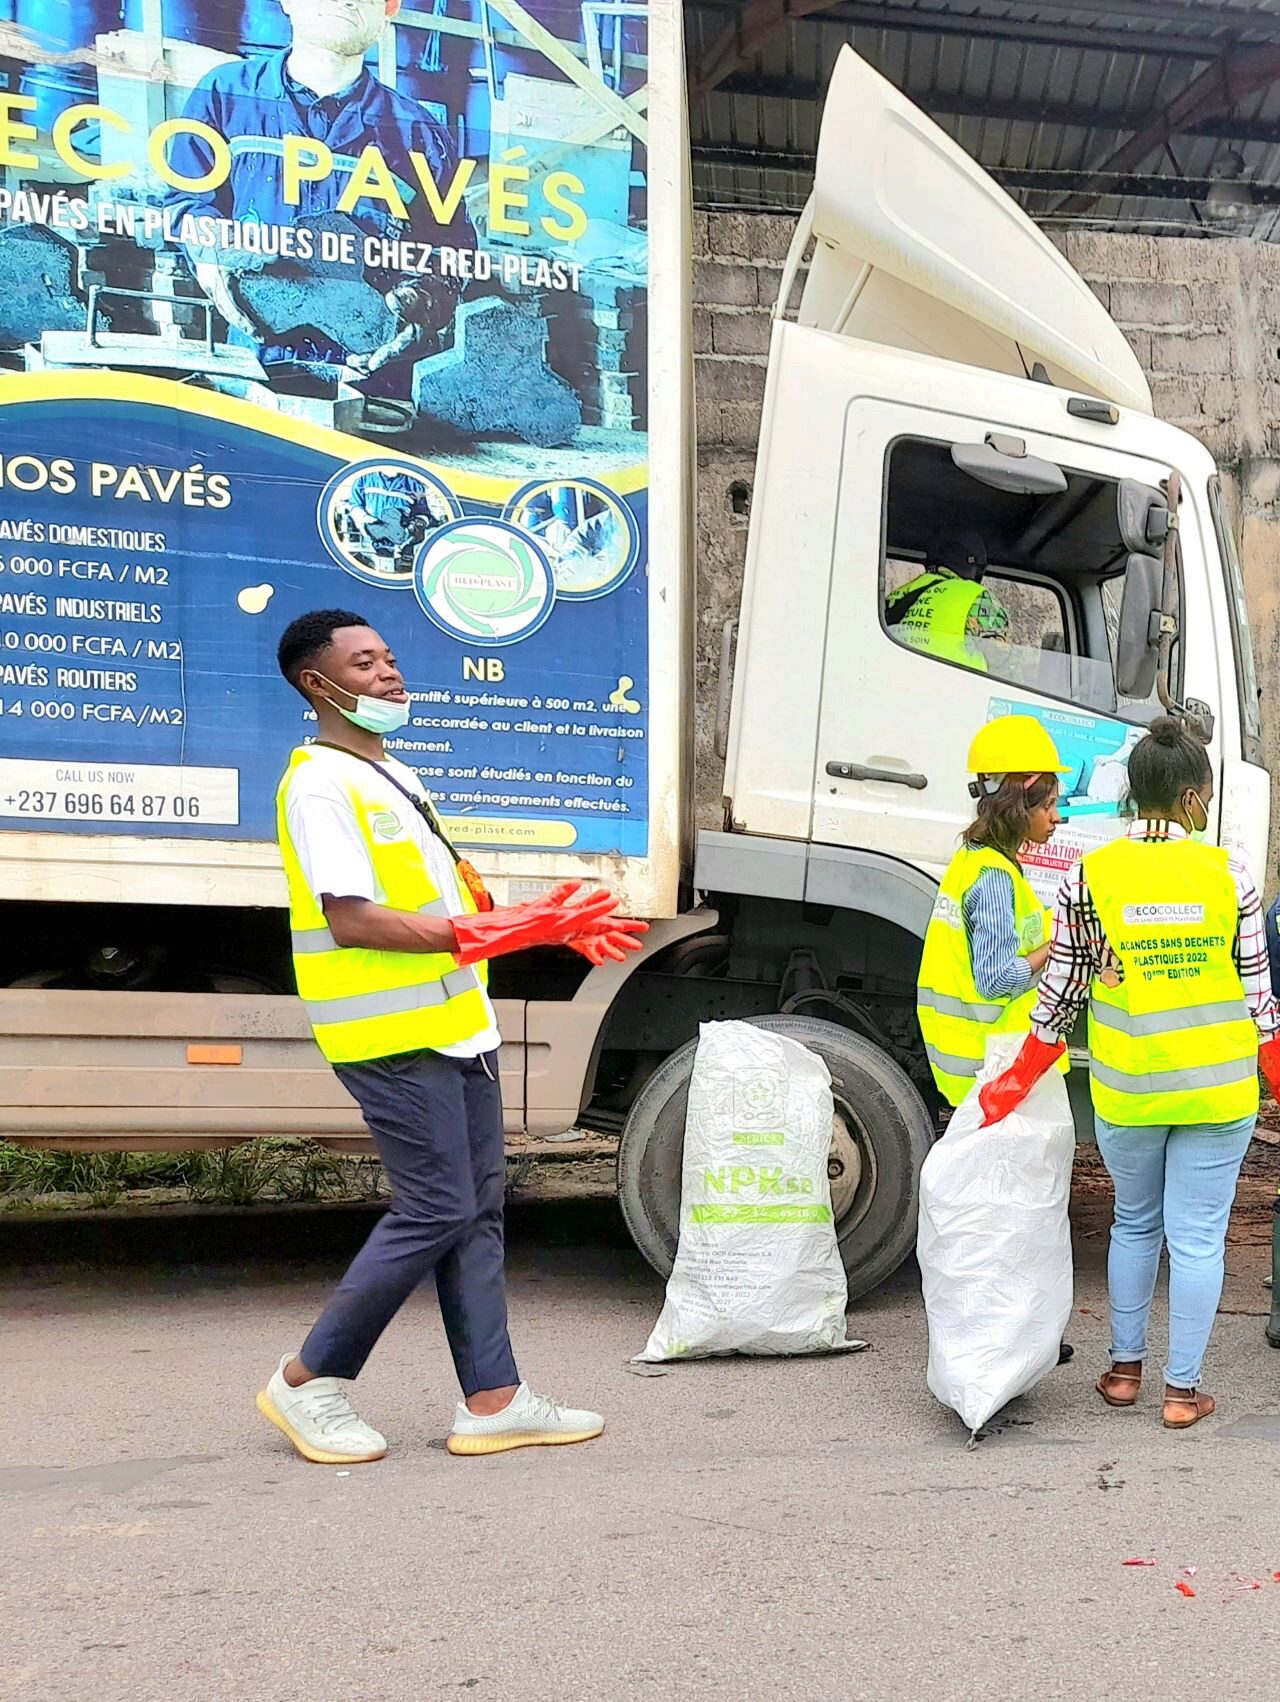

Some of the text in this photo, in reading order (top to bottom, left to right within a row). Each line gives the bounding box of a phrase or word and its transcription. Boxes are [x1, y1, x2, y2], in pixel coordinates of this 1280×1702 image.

[0, 93, 588, 241] ECO PAVÉS
[0, 190, 583, 292] PAVÉS EN PLASTIQUES DE CHEZ RED-PLAST
[0, 454, 233, 509] OS PAVÉS
[0, 519, 166, 552] AVÉS DOMESTIQUES
[10, 556, 53, 576] 000
[58, 559, 114, 581] FCFA
[118, 564, 130, 583] /
[134, 566, 170, 586] M2
[0, 592, 162, 624] AVÉS INDUSTRIELS
[0, 631, 181, 660] 0 000 FCFA / M2
[57, 668, 137, 692] ROUTIERS
[462, 656, 505, 682] NB
[30, 701, 75, 720] 000
[407, 689, 452, 703] antité
[453, 692, 529, 708] supérieure
[531, 696, 542, 708] à
[545, 698, 570, 710] 500
[492, 721, 511, 732] au
[514, 720, 552, 734] client
[555, 723, 571, 735] et
[573, 724, 586, 736] la
[589, 724, 644, 738] livraison
[382, 737, 454, 752] tuitement.
[55, 769, 136, 784] CALL US NOW
[447, 766, 478, 778] sont
[481, 767, 531, 780] étudiés
[535, 772, 553, 782] en
[556, 771, 612, 786] fonction
[615, 775, 634, 787] du
[4, 790, 200, 818] +237 696 64 87 06
[427, 788, 630, 812] es aménagements effectués.
[1160, 937, 1182, 949] SANS
[1184, 936, 1226, 948] DECHETS
[1134, 952, 1207, 966] PLASTIQUES 2022
[1168, 967, 1201, 979] EDITION
[703, 1165, 784, 1196] NPK
